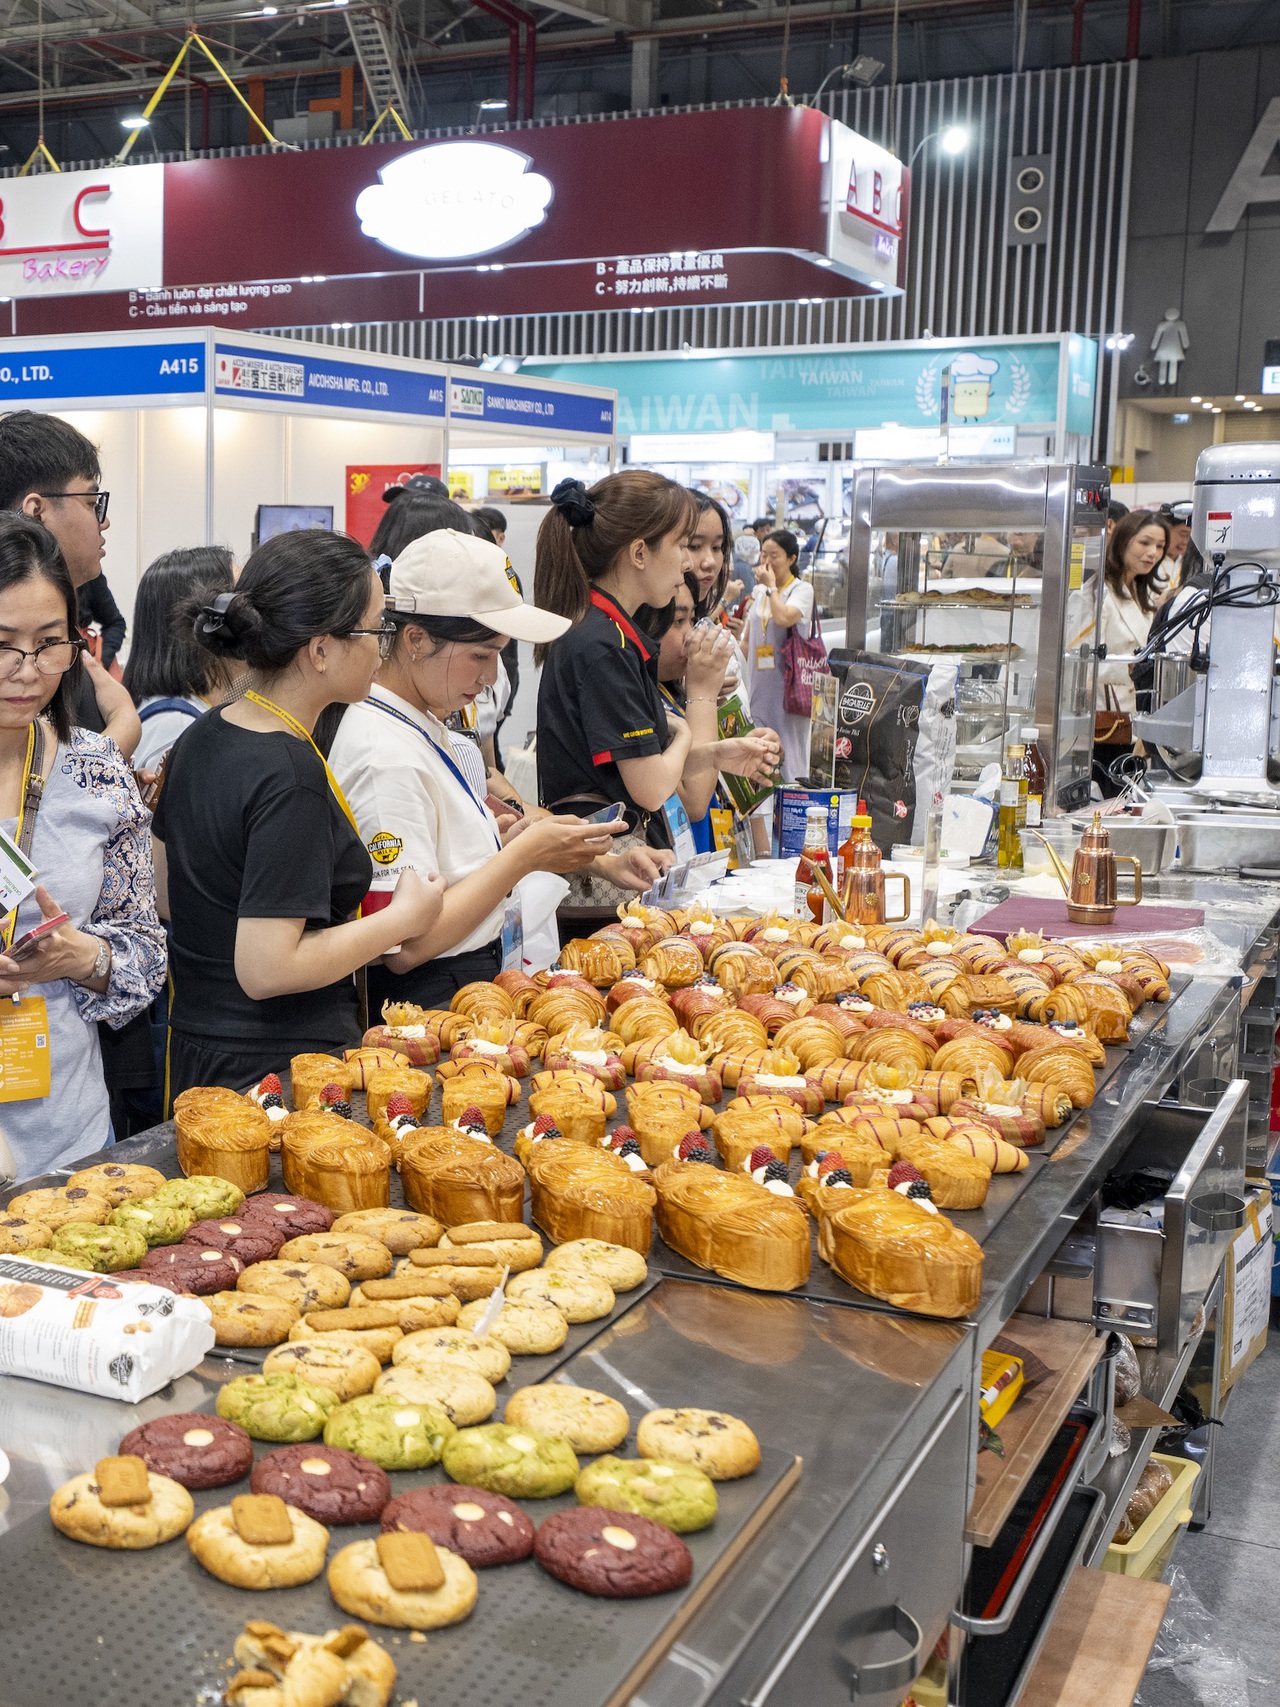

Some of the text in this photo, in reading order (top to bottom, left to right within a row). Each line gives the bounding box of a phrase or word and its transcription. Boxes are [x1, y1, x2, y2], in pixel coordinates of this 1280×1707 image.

[22, 256, 108, 281] Bakery
[22, 366, 53, 382] LTD.
[159, 358, 199, 375] A415
[308, 372, 345, 390] AICOHSHA
[799, 370, 863, 386] TAIWAN
[618, 393, 759, 431] AIWAN
[368, 838, 402, 853] CALIFORNIA
[377, 848, 394, 856] MILK
[381, 868, 390, 878] FOR
[390, 867, 400, 875] THE
[1, 874, 23, 897] CATALOGUE
